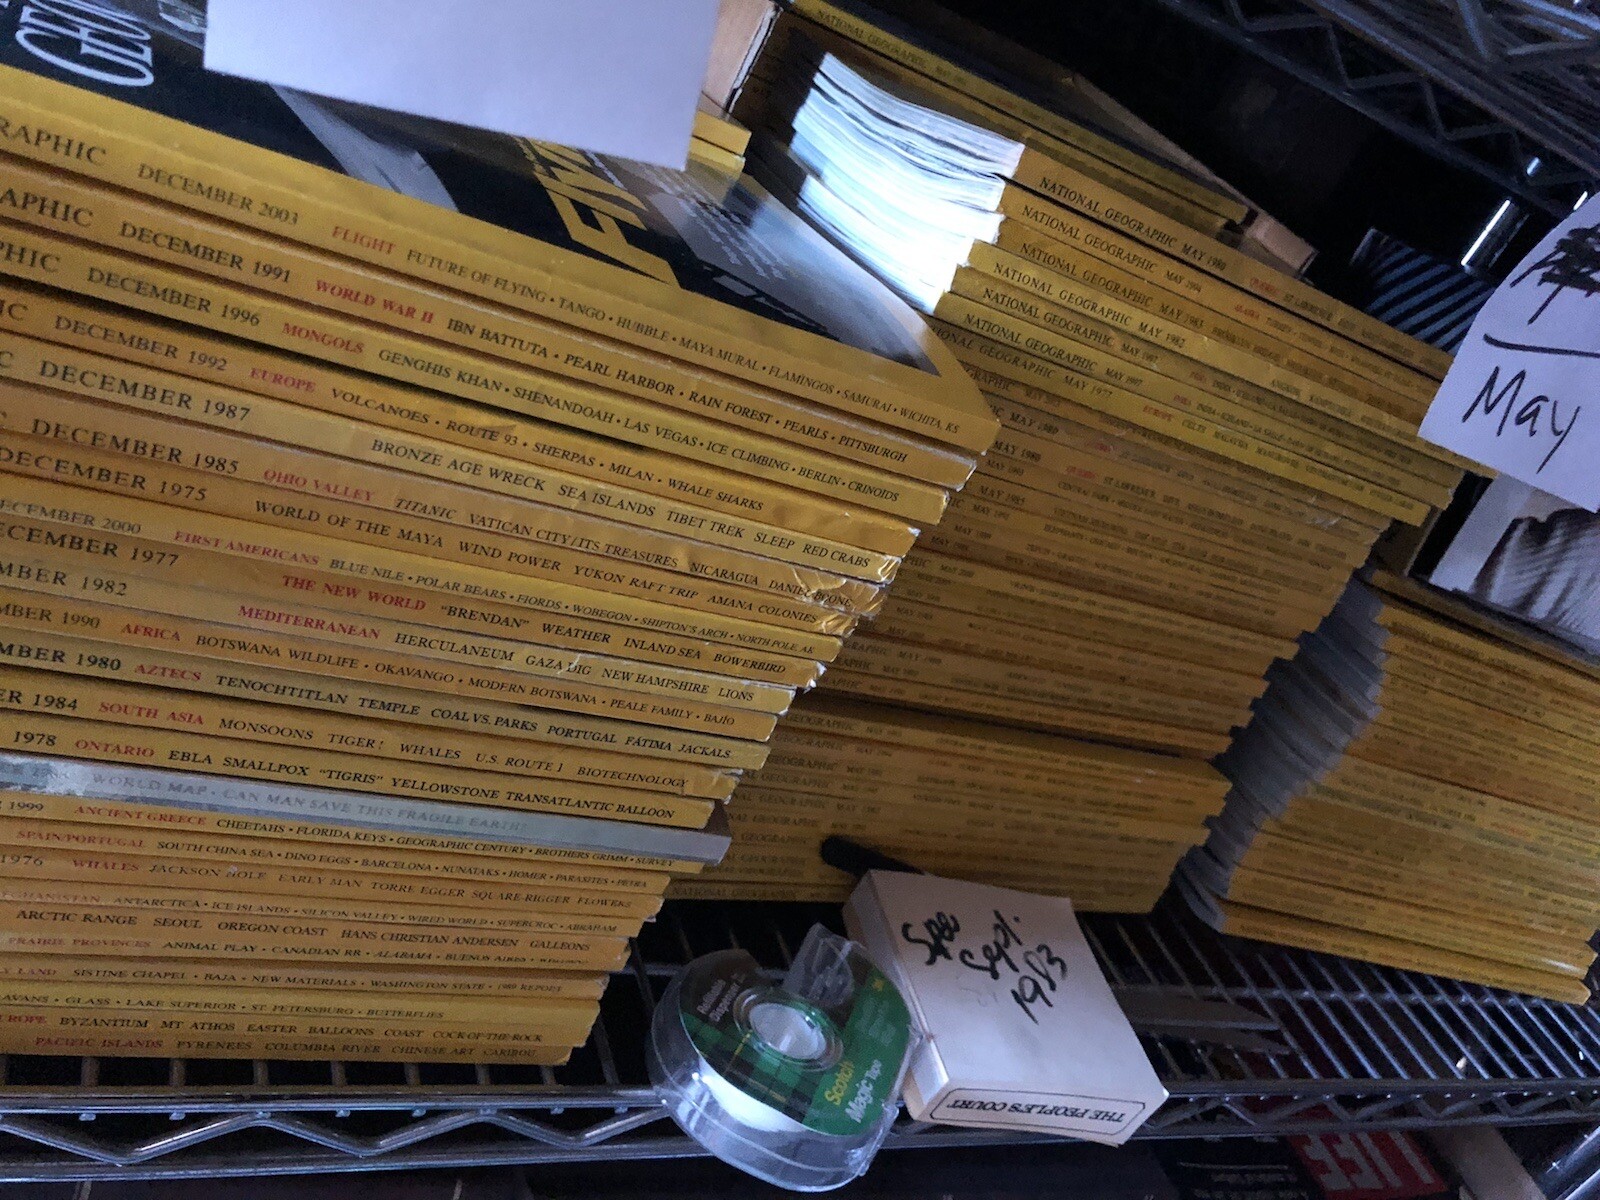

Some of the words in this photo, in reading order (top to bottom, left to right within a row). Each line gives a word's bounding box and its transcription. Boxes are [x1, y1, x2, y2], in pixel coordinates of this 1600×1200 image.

[1021, 204, 1082, 240] NATIONAL
[1083, 233, 1157, 273] GEOGRAPHIC
[1163, 270, 1184, 285] MAY
[1038, 176, 1102, 213] NATIONAL
[1103, 207, 1177, 248] GEOGRAPHIC
[1181, 243, 1205, 261] MAY
[135, 163, 254, 211] DECEMBER
[331, 225, 396, 255] FLIGHT
[557, 297, 605, 321] TANGO
[615, 316, 669, 341] HUBBLE
[678, 337, 714, 356] MAYA
[716, 349, 760, 370] MURAL
[993, 263, 1055, 295] NATIONAL
[1058, 289, 1132, 325] GEOGRAPHIC
[1137, 321, 1162, 338] MAY
[1081, 270, 1153, 307] GEOGRAPHIC
[1158, 303, 1183, 320] MAY
[119, 222, 245, 270] DECEMBER
[478, 328, 549, 357] BATTUTA
[564, 353, 612, 376] PEARL
[615, 369, 675, 395] HARBOR
[688, 391, 722, 409] RAIN
[724, 402, 772, 423] FOREST
[963, 314, 1022, 343] NATIONAL
[1023, 336, 1098, 371] GEOGRAPHIC
[982, 288, 1040, 317] NATIONAL
[1042, 312, 1114, 346] GEOGRAPHIC
[86, 267, 213, 314] DECEMBER
[281, 322, 364, 354] MONGOLS
[377, 348, 452, 378] GENGHIS
[455, 370, 502, 392] KHAN
[512, 386, 614, 423] SHENANDOAH
[731, 448, 789, 472] CLIMBING
[978, 343, 1055, 379] GEOGRAPHIC
[1062, 375, 1087, 390] MAY
[54, 315, 178, 358] DECEMBER
[330, 389, 430, 423] VOLCANOES
[445, 418, 499, 441] ROUTE
[532, 442, 594, 466] SHERPAS
[667, 478, 713, 498] WHALE
[715, 491, 763, 511] SHARKS
[1463, 366, 1581, 473] May
[39, 360, 193, 407] DECEMBER
[371, 440, 442, 466] BRONZE
[487, 467, 545, 490] WRECK
[591, 492, 655, 516] ISLANDS
[665, 511, 706, 528] TIBET
[754, 532, 795, 549] SLEEP
[32, 418, 184, 462] DECEMBER
[193, 453, 239, 474] 1985
[394, 498, 456, 519] TITANIC
[468, 514, 532, 536] VATICAN
[604, 544, 678, 567] TREASURES
[690, 562, 759, 585] NICARAGUA
[254, 499, 320, 523] WORLD
[326, 513, 352, 528] OF
[354, 520, 391, 536] THE
[397, 528, 444, 547] MAYA
[507, 551, 561, 571] POWER
[573, 565, 624, 583] YUKON
[225, 540, 320, 564] AMERICANS
[329, 559, 368, 573] BLUE
[371, 567, 404, 580] NILE
[415, 575, 458, 590] POLAR
[572, 604, 632, 622] WOBEGON
[701, 626, 728, 638] ARCH
[281, 576, 316, 591] THE
[322, 583, 361, 599] NEW
[367, 591, 426, 610] WORLD
[541, 623, 611, 643] WEATHER
[623, 637, 676, 655] INLAND
[678, 646, 701, 659] SEA
[80, 576, 127, 596] 1982
[238, 606, 379, 639] MEDITERRANEAN
[394, 633, 514, 662] HERCULANEUM
[601, 668, 633, 681] NEW
[635, 673, 709, 694] HAMPSHIRE
[718, 687, 754, 701] LIONS
[121, 623, 181, 641] AFRICA
[195, 635, 281, 656] BOTSWANA
[287, 649, 359, 668] WILDLIFE
[374, 663, 455, 682] OKAVANGO
[530, 686, 597, 704] BOTSWANA
[650, 705, 693, 718] FAMILY
[98, 702, 158, 718] SOUTH
[167, 711, 205, 724] ASIA
[219, 719, 314, 739] MONSOONS
[400, 743, 461, 759] WHALES
[505, 757, 551, 770] ROUTE
[577, 767, 688, 787] BIOTECHNOLOGY
[134, 663, 201, 681] AZTECS
[215, 675, 348, 704] TENOCHTITLAN
[358, 698, 420, 715] TEMPLE
[494, 716, 538, 731] PARKS
[547, 725, 617, 743] PORTUGAL
[678, 744, 731, 758] JACKALS
[74, 740, 155, 757] ONTARIO
[168, 750, 213, 764] EBLA
[222, 757, 309, 775] SMALLPOX
[390, 778, 499, 799] YELLOWSTONE
[506, 791, 615, 811] TRANSATLANTIC
[616, 804, 674, 818] BALLOON
[167, 781, 207, 794] MAP
[147, 812, 206, 824] GREECE
[216, 819, 285, 832] CHEETAHS
[296, 825, 351, 838] FLORIDA
[354, 832, 386, 842] KEYS
[157, 841, 203, 851] SOUTH
[206, 844, 247, 855] CHINA
[284, 851, 316, 860] DINO
[361, 858, 431, 870] BARCELONA
[72, 859, 139, 871] WHALES
[331, 878, 362, 887] MAN
[372, 882, 415, 892] TORRE
[420, 886, 464, 896] EGGER
[82, 913, 137, 924] RANGE
[153, 917, 202, 928] SEOUL
[218, 921, 279, 932] OREGON
[283, 925, 328, 935] COAST
[340, 929, 376, 939] HANS
[380, 932, 448, 943] CHRISTIAN
[162, 941, 219, 949] ANIMAL
[1012, 944, 1068, 1025] 1983
[161, 1020, 183, 1028] MT
[189, 1021, 235, 1030] ATHOS
[247, 1023, 297, 1032] EASTER
[308, 1025, 374, 1035] BALLOONS
[825, 1061, 855, 1105] Scotch
[845, 1073, 875, 1123] Magic
[946, 1098, 1007, 1112] COURT
[1088, 1106, 1125, 1123] THE
